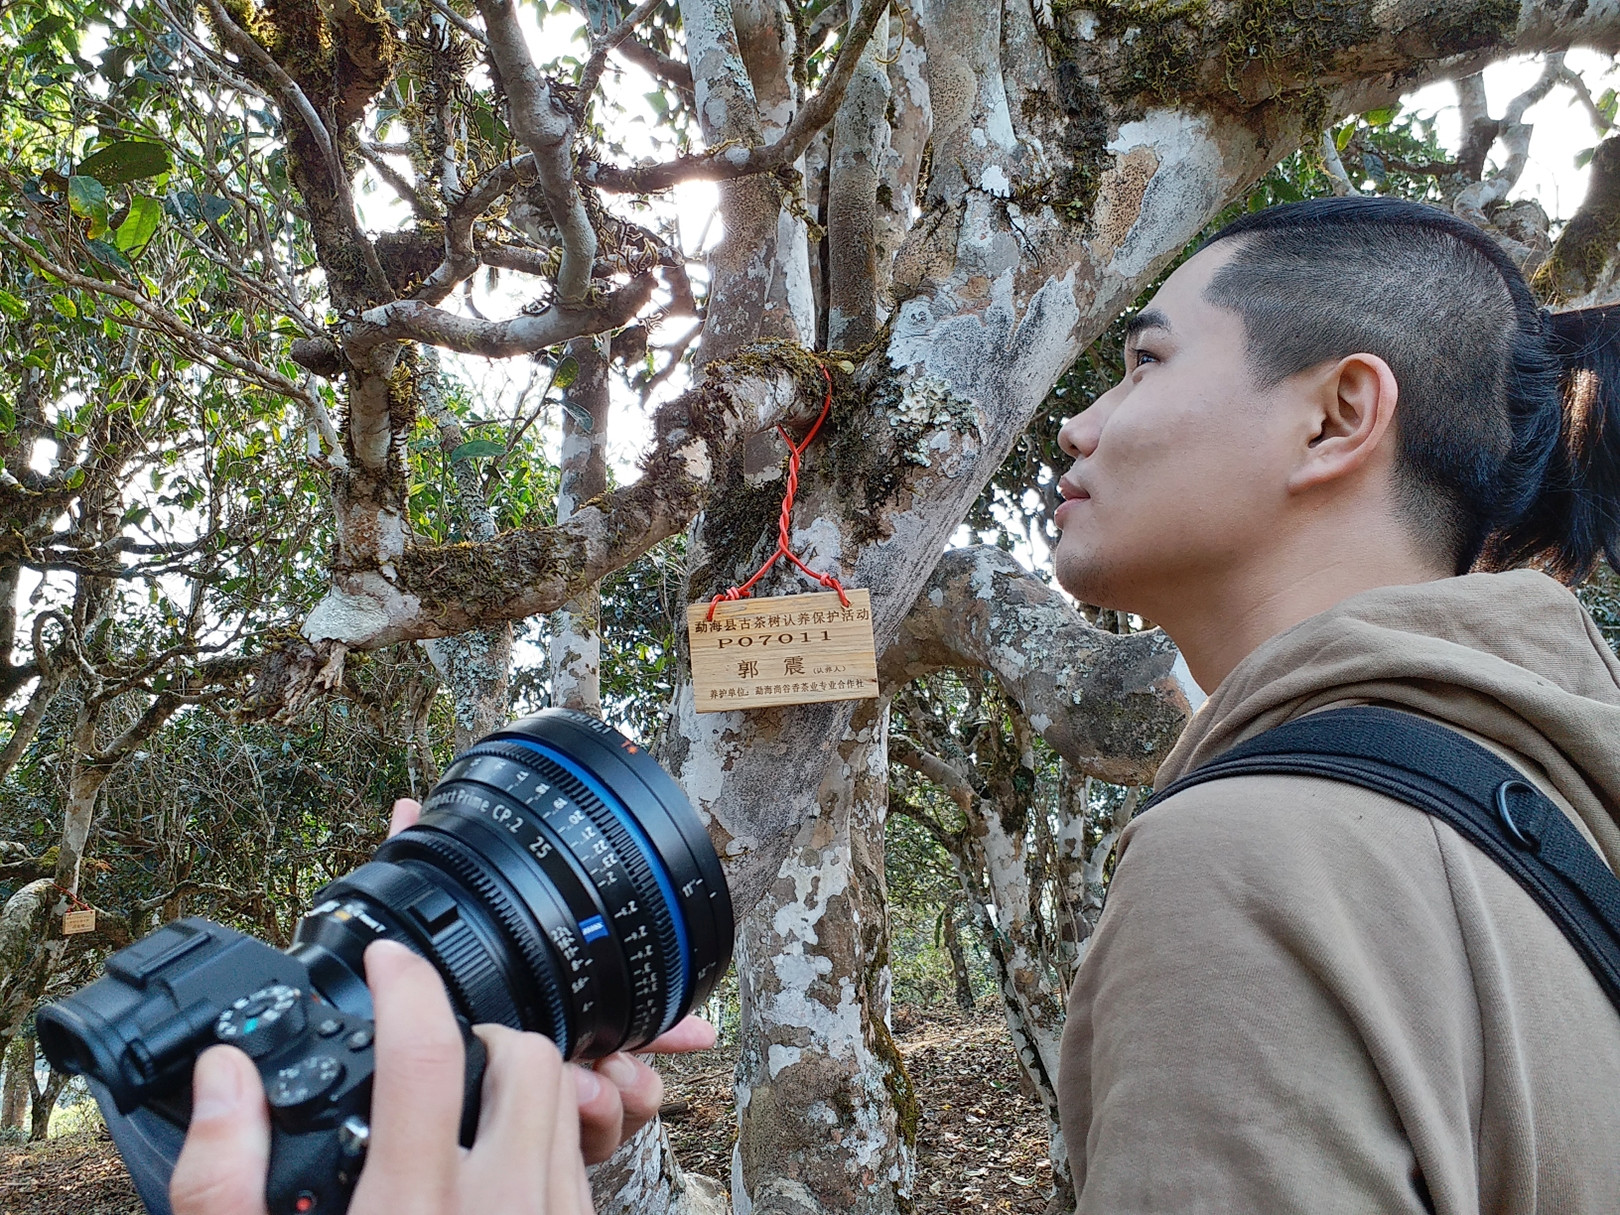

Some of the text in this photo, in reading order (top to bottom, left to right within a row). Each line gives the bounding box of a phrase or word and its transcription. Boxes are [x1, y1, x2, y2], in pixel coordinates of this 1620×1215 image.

[694, 608, 870, 633] 勐海县古茶树认养保护活动
[457, 788, 490, 813] Prime
[491, 804, 524, 834] CP.2
[528, 835, 554, 859] 25
